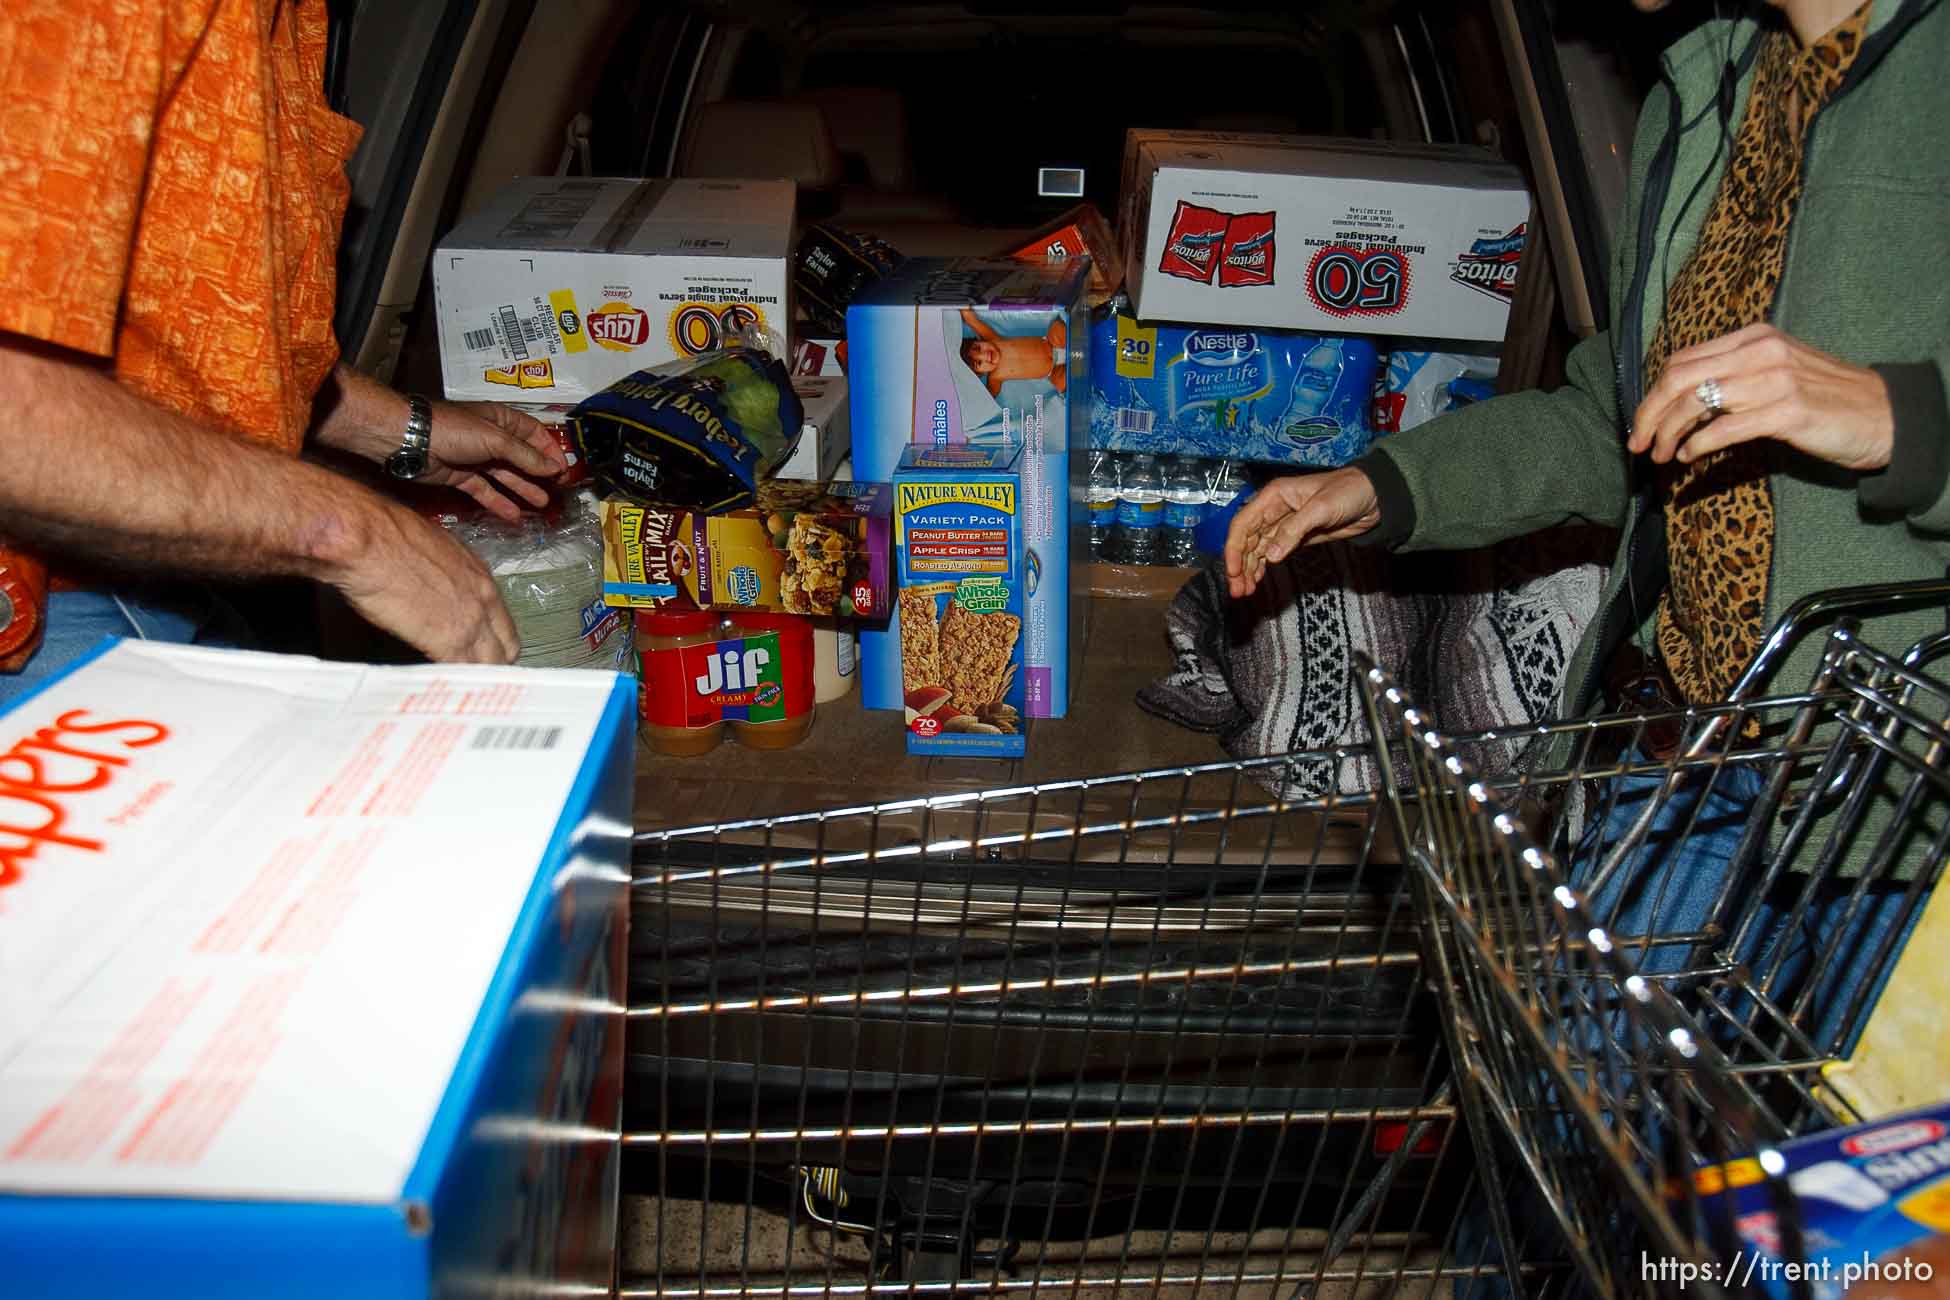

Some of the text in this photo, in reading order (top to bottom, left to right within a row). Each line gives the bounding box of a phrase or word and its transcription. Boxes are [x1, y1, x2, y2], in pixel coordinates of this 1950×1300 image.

[1304, 238, 1426, 255] Individual Single Serve
[1336, 231, 1398, 244] Packages
[804, 255, 829, 280] Farms
[813, 246, 836, 269] Taylor
[687, 286, 749, 296] Packages
[1318, 259, 1400, 309] 50
[659, 293, 778, 305] Individual Single Serve
[531, 317, 544, 340] CLUB
[543, 304, 561, 345] REGULAR
[1122, 337, 1150, 355] 30
[1183, 365, 1260, 388] Pure Life
[934, 400, 948, 447] añales
[624, 453, 659, 477] Farms
[902, 485, 958, 510] NATURE
[959, 485, 1012, 509] VALLEY
[645, 509, 669, 544] MIX
[911, 514, 1005, 526] VARIETY PACK
[912, 531, 946, 540] PEANUT
[946, 531, 981, 540] BUTTER
[913, 546, 947, 556] APPLE
[948, 546, 981, 556] CRISP
[699, 564, 708, 591] FRUIT
[913, 561, 949, 571] ROASTED
[949, 561, 982, 571] ALMOND
[627, 555, 652, 606] NTURE
[737, 565, 748, 607] Whole
[748, 570, 758, 602] Grain
[855, 586, 867, 608] 35
[957, 584, 1009, 601] Whole
[964, 597, 1006, 610] Grain
[695, 647, 770, 697] Jif
[710, 693, 747, 705] CREAMY
[917, 718, 937, 729] 70
